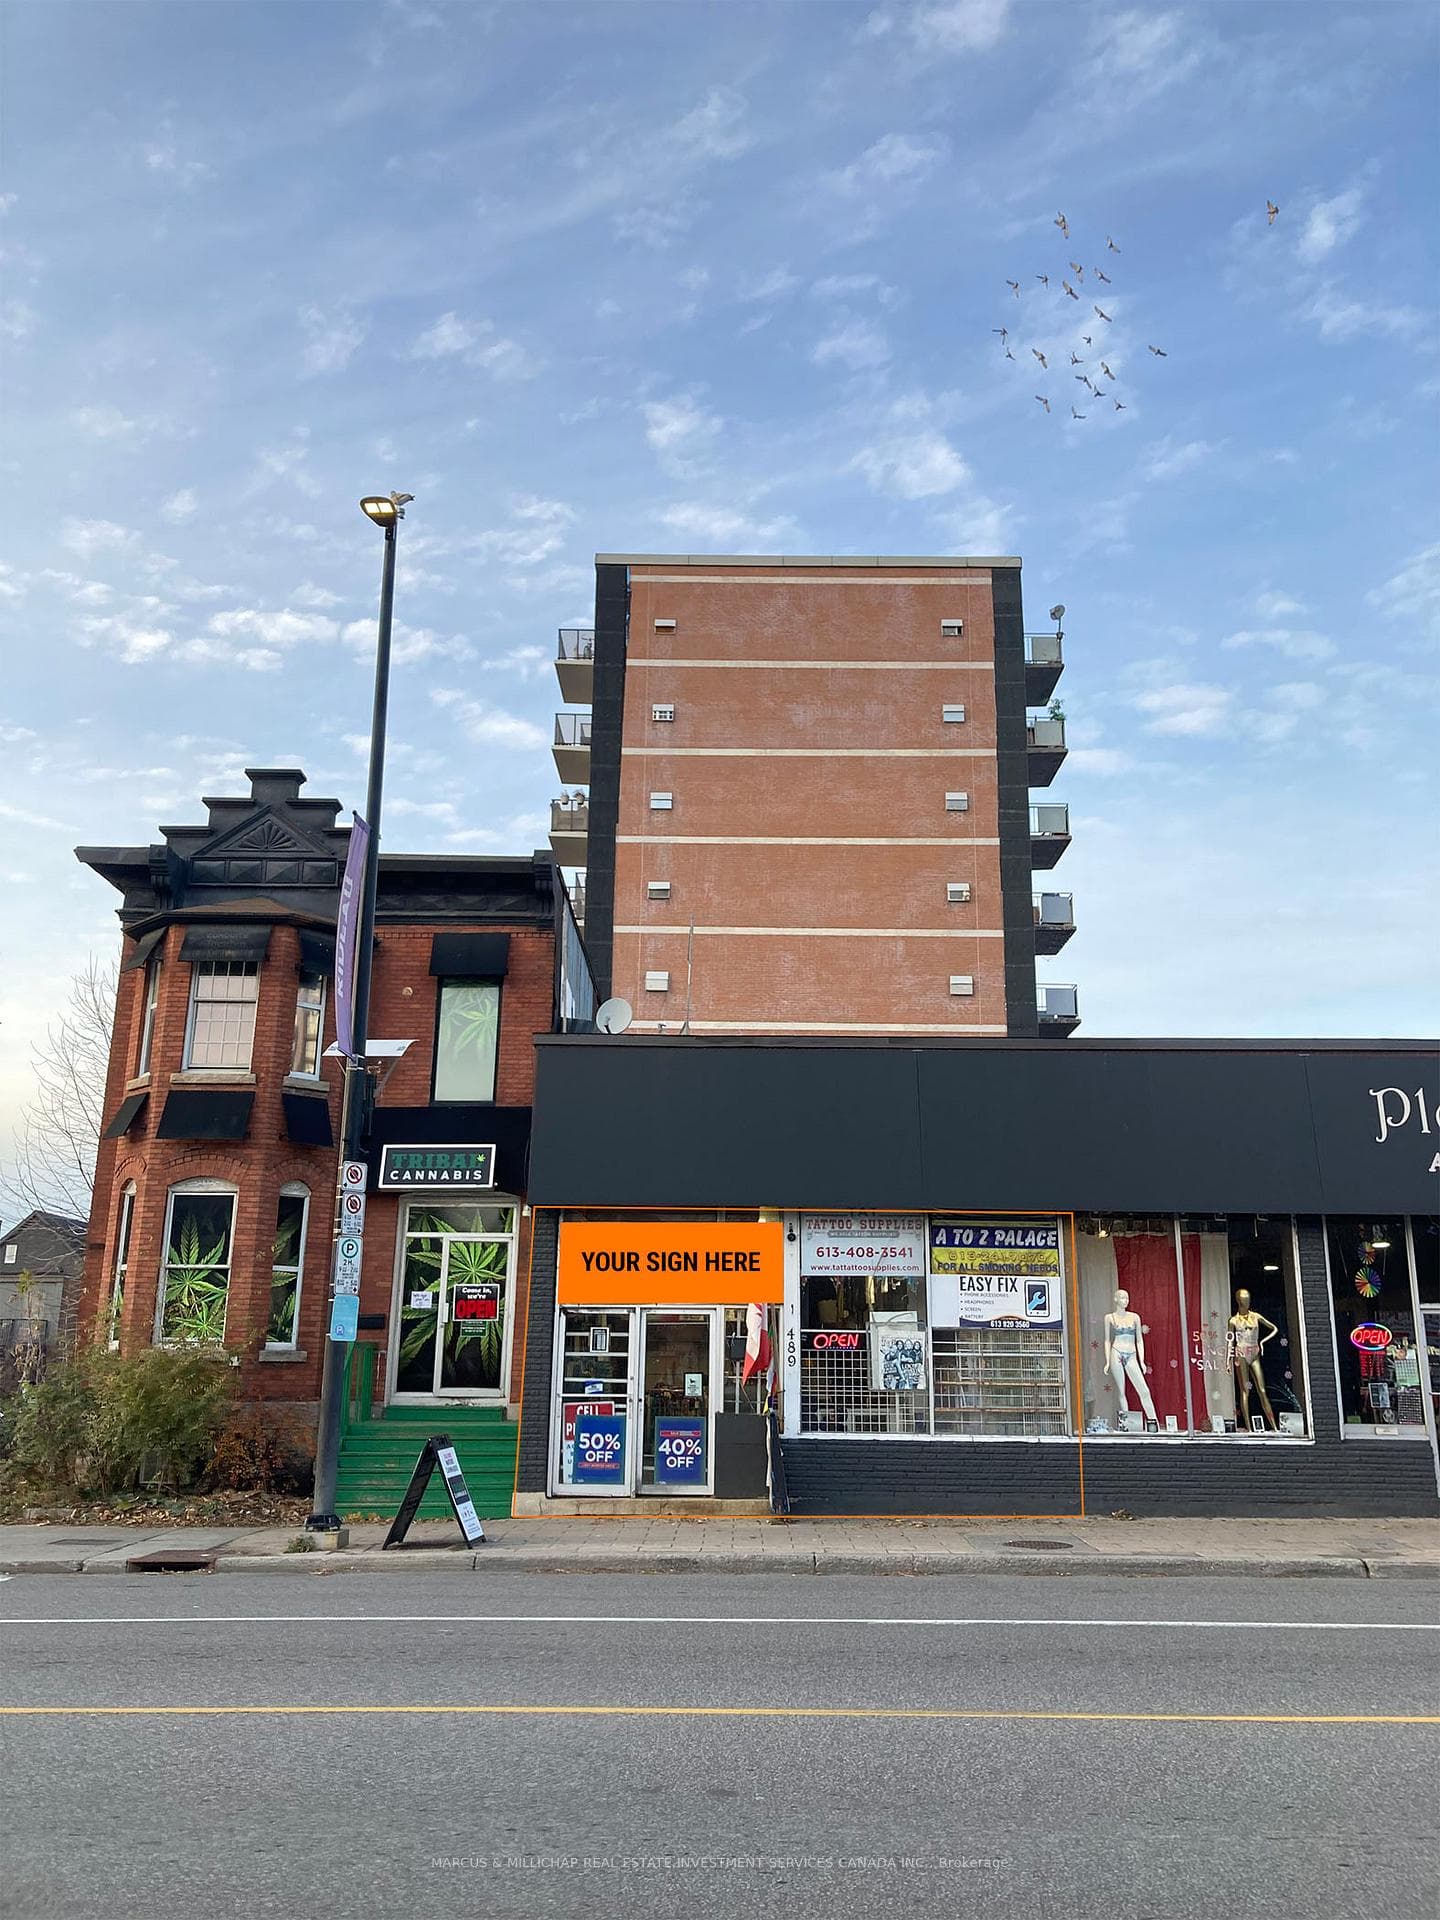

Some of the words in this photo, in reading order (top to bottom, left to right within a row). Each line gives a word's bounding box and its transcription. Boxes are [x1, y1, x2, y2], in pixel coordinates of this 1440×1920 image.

[1369, 1087, 1440, 1142] Pl
[391, 1153, 482, 1168] TRIBAL
[390, 1170, 482, 1180] CANNABIS
[806, 1219, 853, 1230] TATTOO
[860, 1219, 922, 1230] SUPPLIES
[935, 1228, 947, 1245] A
[952, 1228, 974, 1245] TO
[978, 1229, 989, 1246] Z
[994, 1229, 1057, 1247] PALACE
[816, 1247, 913, 1258] 613-408-3541
[581, 1251, 641, 1272] YOUR
[646, 1251, 698, 1272] SIGN
[705, 1251, 761, 1272] HERE
[938, 1262, 957, 1271] FOR
[959, 1262, 977, 1271] ALL
[979, 1262, 1022, 1272] SMOKING
[1027, 1264, 1058, 1273] NEEDS
[462, 1286, 481, 1295] Come
[960, 1276, 993, 1292] EASY
[997, 1277, 1018, 1293] FIX
[456, 1299, 496, 1319] OPEN
[991, 1320, 1001, 1328] 613
[813, 1333, 859, 1349] OPEN
[1354, 1330, 1388, 1344] OPEN
[579, 1433, 620, 1450] 50%
[658, 1439, 702, 1456] 40%
[585, 1450, 613, 1462] OFF
[666, 1457, 694, 1468] OFF
